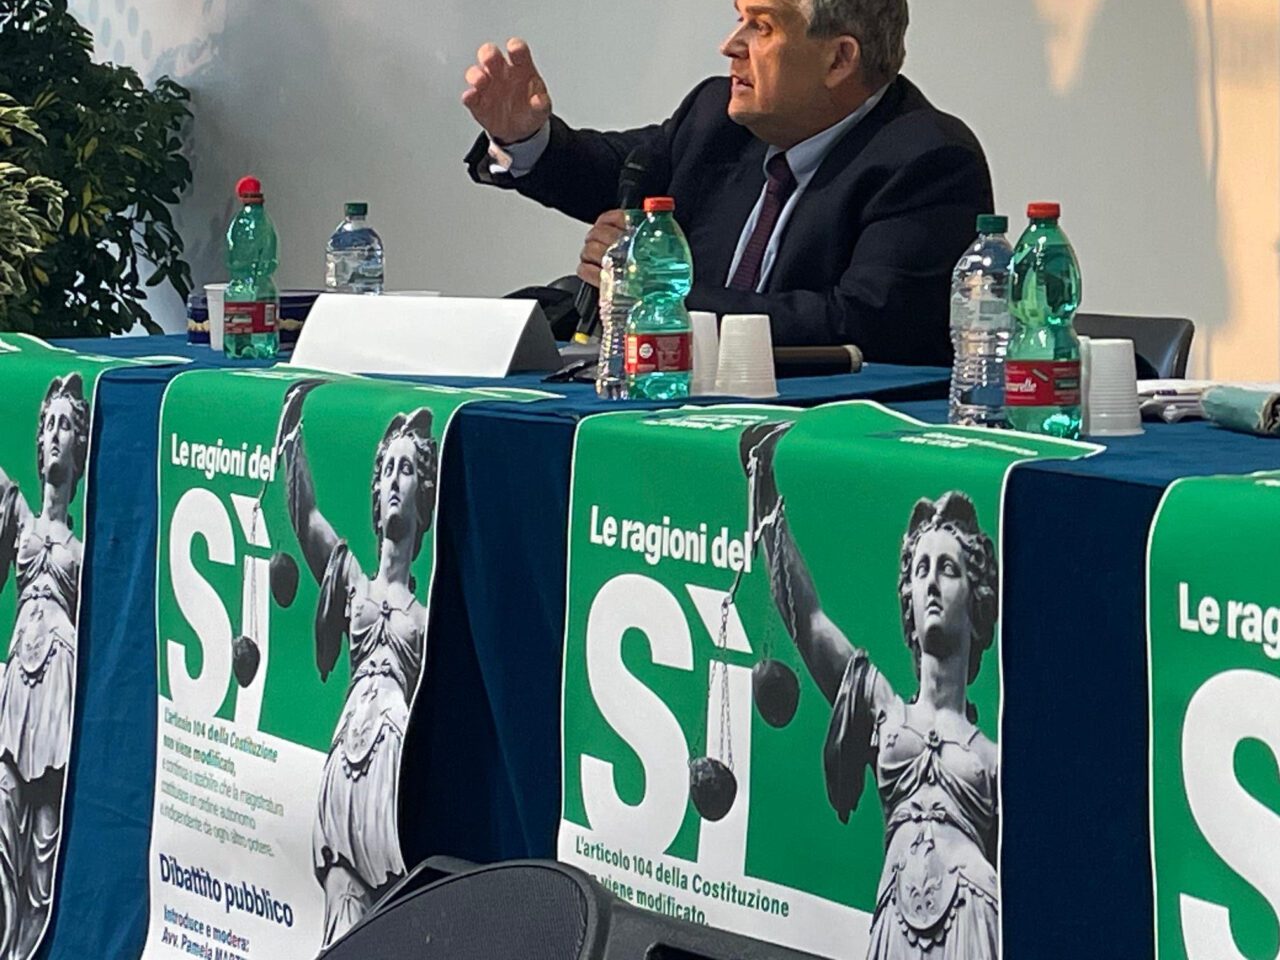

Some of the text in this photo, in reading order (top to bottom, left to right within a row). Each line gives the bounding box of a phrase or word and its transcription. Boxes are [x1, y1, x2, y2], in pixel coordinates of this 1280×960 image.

[172, 432, 277, 482] Le ragioni del
[590, 505, 753, 573] Le ragioni del
[1179, 582, 1221, 635] Le
[580, 573, 753, 876] Sì
[159, 852, 293, 928] Dibattito pubblico
[576, 835, 790, 918] L'articolo 104 della Costituzione
[205, 924, 211, 938] e
